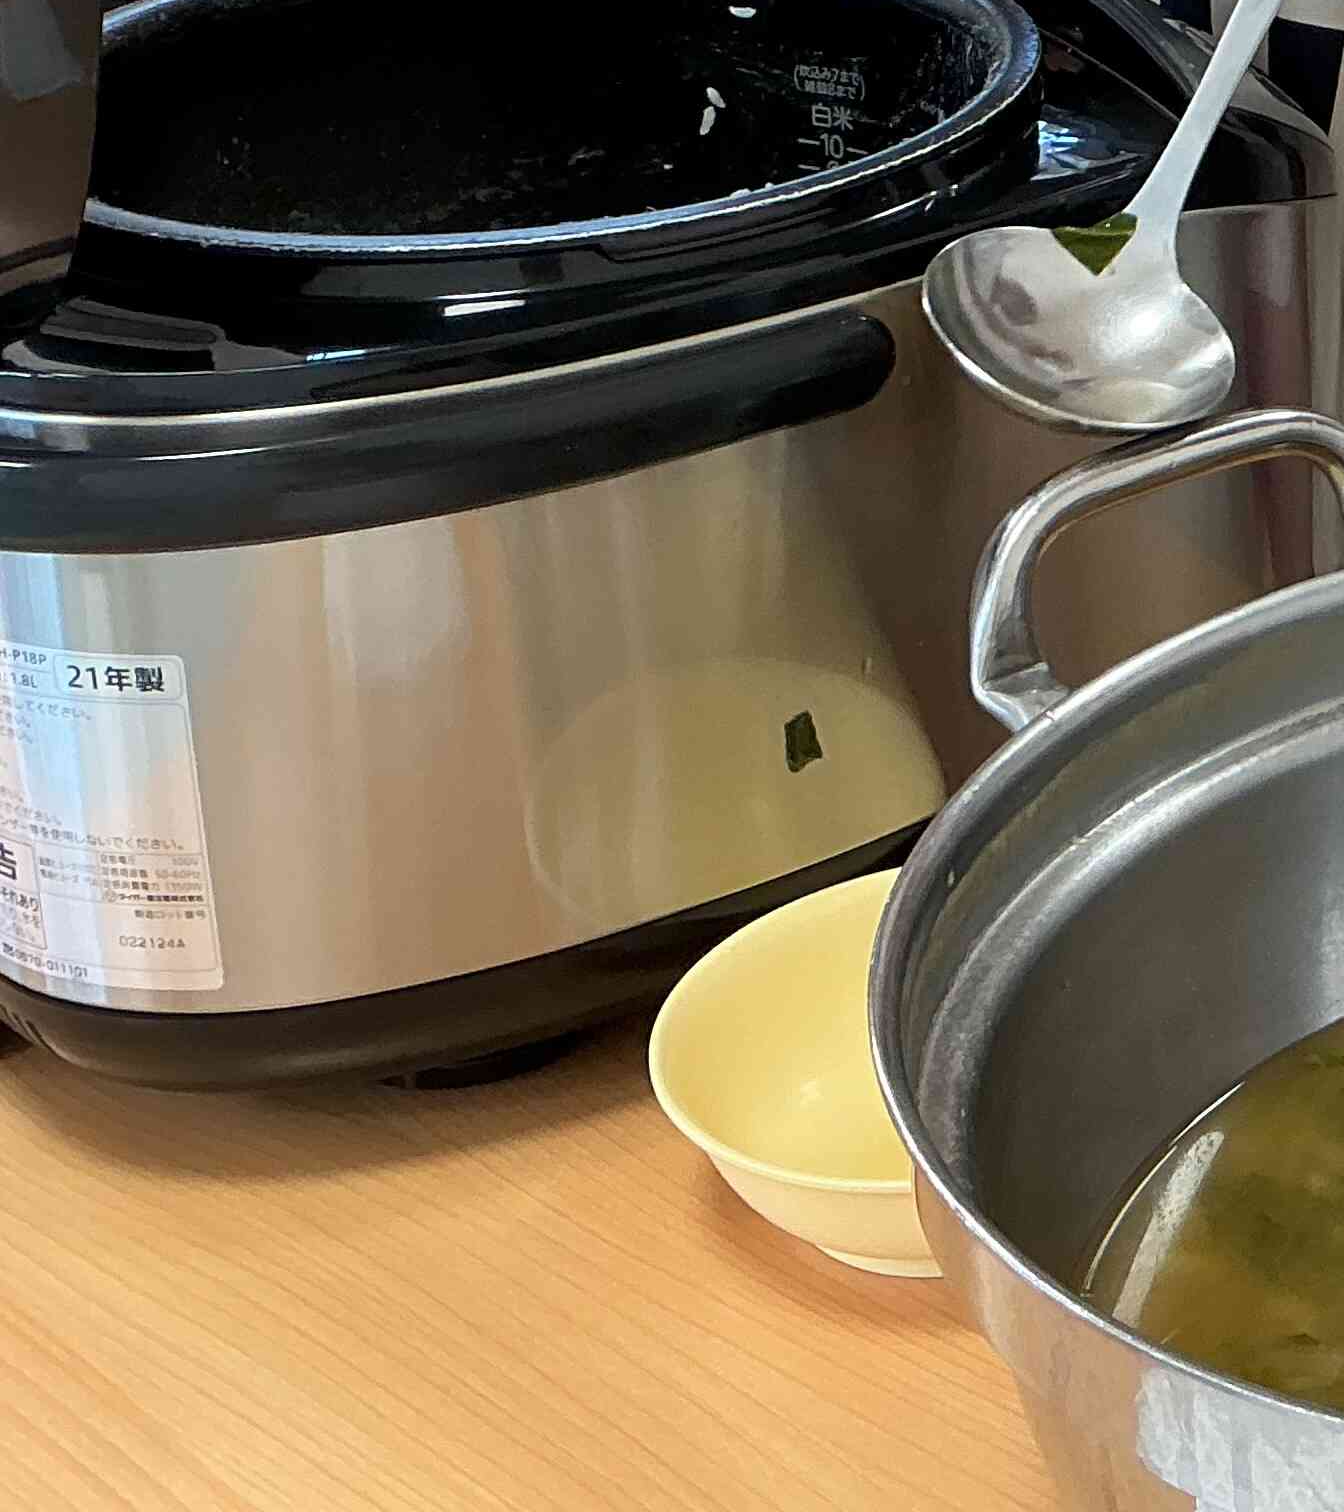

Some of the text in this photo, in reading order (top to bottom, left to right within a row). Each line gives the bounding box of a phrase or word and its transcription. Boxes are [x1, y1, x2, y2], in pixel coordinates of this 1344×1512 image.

[811, 102, 854, 131] 白米
[819, 132, 845, 159] 10
[66, 665, 165, 692] 21年製
